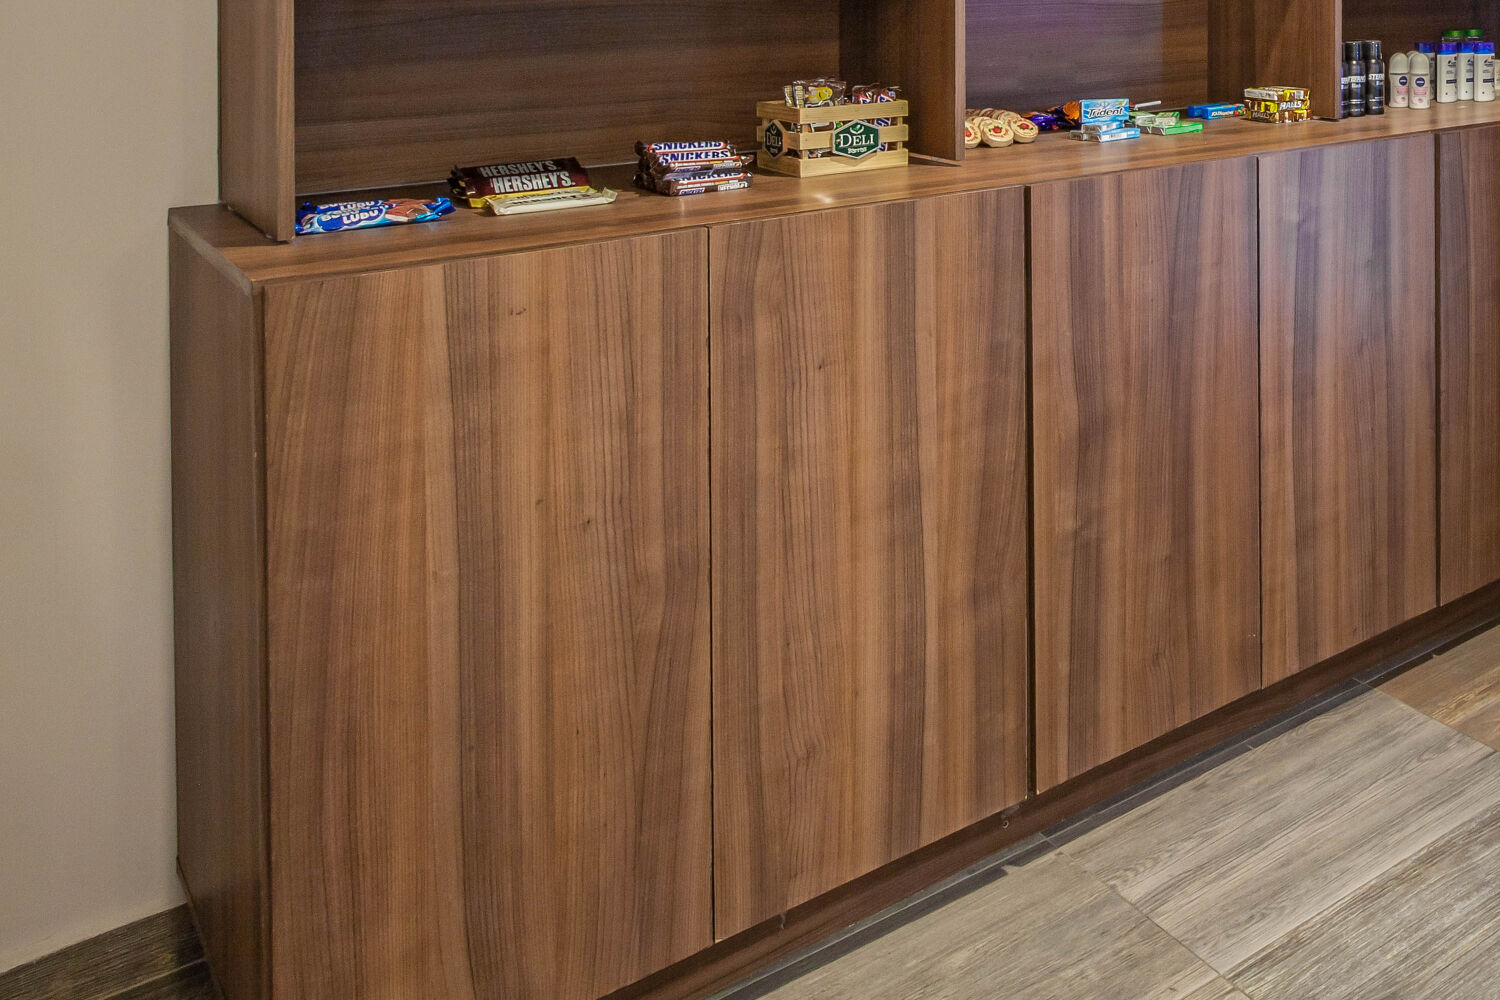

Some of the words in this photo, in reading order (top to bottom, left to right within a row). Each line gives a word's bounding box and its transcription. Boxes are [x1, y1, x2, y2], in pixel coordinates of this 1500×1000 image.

[1280, 100, 1302, 110] HALLS
[1088, 108, 1124, 118] Trident
[839, 133, 874, 147] DELI
[660, 150, 729, 165] SNICKERS
